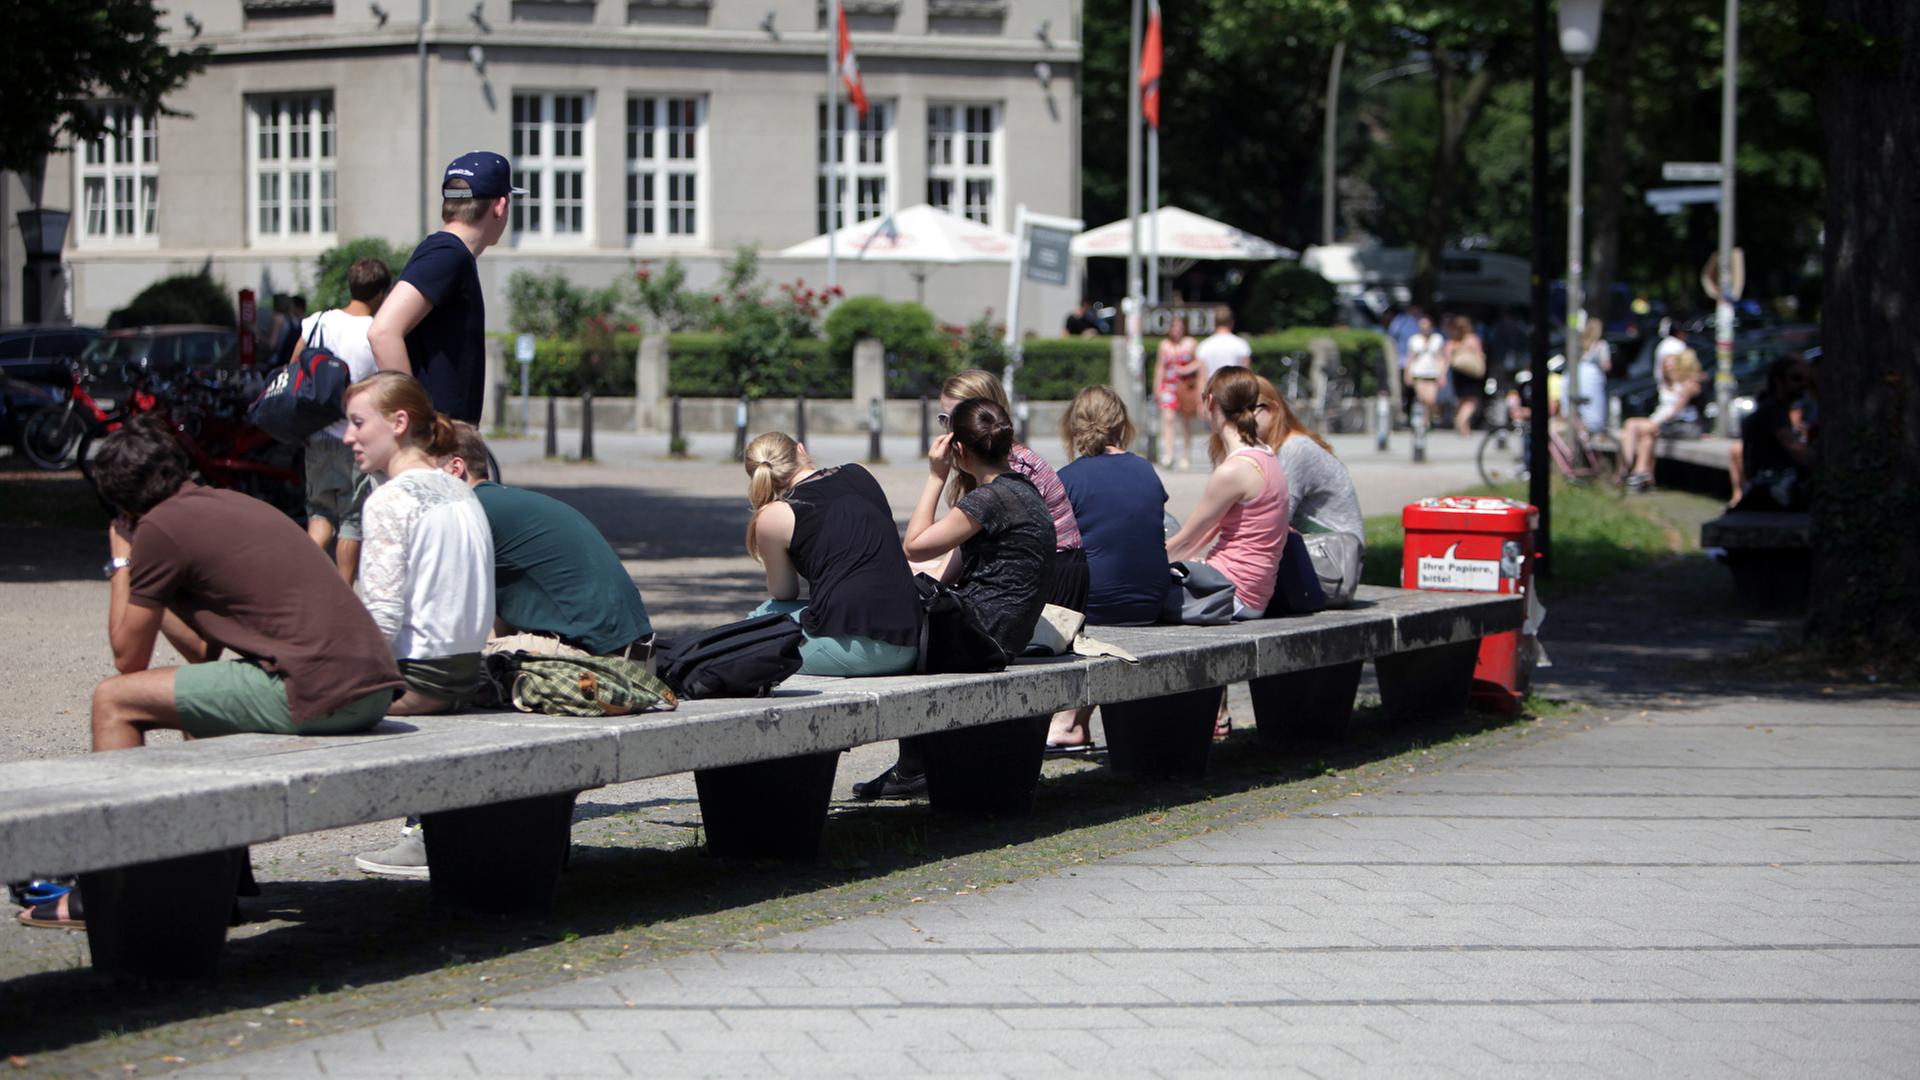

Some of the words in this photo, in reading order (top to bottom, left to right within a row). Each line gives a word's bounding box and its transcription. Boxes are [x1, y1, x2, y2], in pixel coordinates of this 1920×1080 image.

[1423, 562, 1444, 571] Ihre
[1448, 563, 1493, 574] Papiere,
[1422, 575, 1451, 583] bitte!
